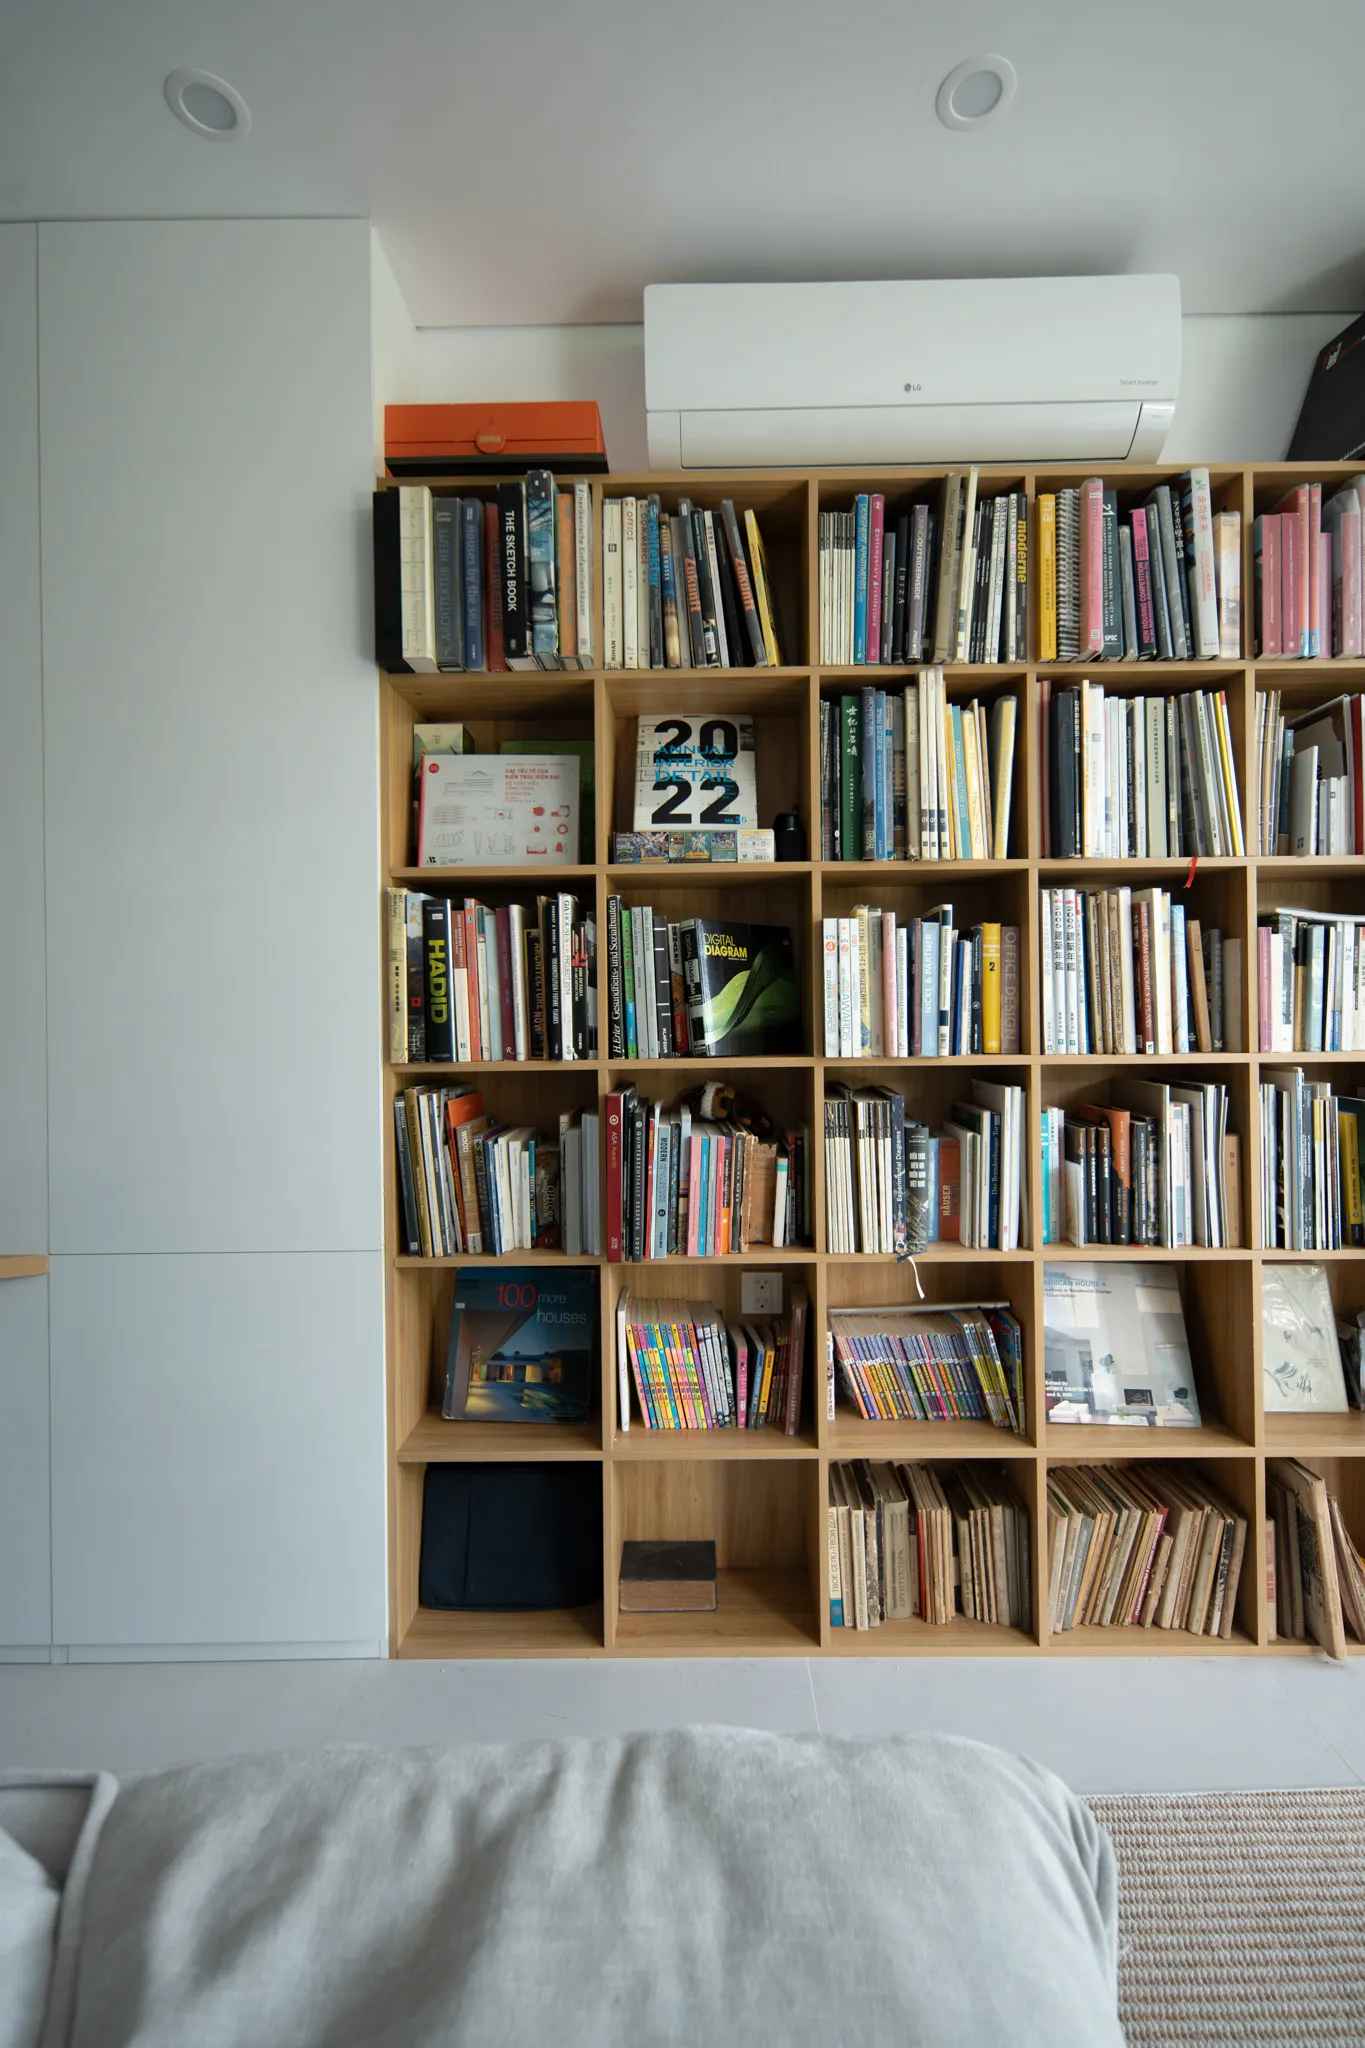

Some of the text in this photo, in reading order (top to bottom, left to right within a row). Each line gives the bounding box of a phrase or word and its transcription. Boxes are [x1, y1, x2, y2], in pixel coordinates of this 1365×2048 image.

[912, 383, 922, 391] LG
[1010, 498, 1017, 510] GA
[1042, 500, 1055, 523] ha
[626, 511, 634, 542] OFFICE
[640, 513, 648, 565] COMMERCE
[944, 488, 957, 576] houses on difficult sites
[504, 510, 517, 612] THE SKETCH BOOK
[1017, 520, 1027, 583] moderne
[465, 524, 478, 627] Houses by the sea
[684, 557, 701, 613] Zukunft
[735, 557, 755, 612] Zukunft
[871, 528, 881, 627] Contemporary Architecture
[1137, 562, 1146, 601] COMPETITION
[1140, 602, 1149, 629] HOUSING
[653, 719, 739, 764] 20
[656, 745, 734, 755] ANNUAL
[655, 758, 735, 768] INTERIOR
[655, 770, 737, 782] DETAIL
[956, 762, 965, 803] ARCHITECTURE
[651, 775, 741, 825] 22
[563, 899, 570, 912] GA
[608, 899, 619, 951] Sozialbauten
[703, 932, 736, 948] DIGITAL
[857, 913, 865, 943] BUILDING
[610, 951, 619, 967] und
[704, 944, 748, 959] DIAGRAM
[989, 961, 996, 972] 2
[428, 939, 448, 1024] HADID
[688, 961, 696, 996] DIAGRAM
[924, 933, 934, 1013] NICKL & PARTNER
[1005, 931, 1017, 1040] OFFICE DESIGN
[841, 994, 851, 1042] AWARDS
[1114, 984, 1122, 1021] Grünflächen
[660, 1137, 668, 1163] MODERN
[895, 1130, 903, 1160] Diagrams
[940, 1185, 950, 1216] HÄUSER
[495, 1283, 567, 1308] 100 more
[1043, 1279, 1073, 1287] ERICAN
[536, 1308, 587, 1324] houses
[828, 1511, 836, 1529] ДОМ
